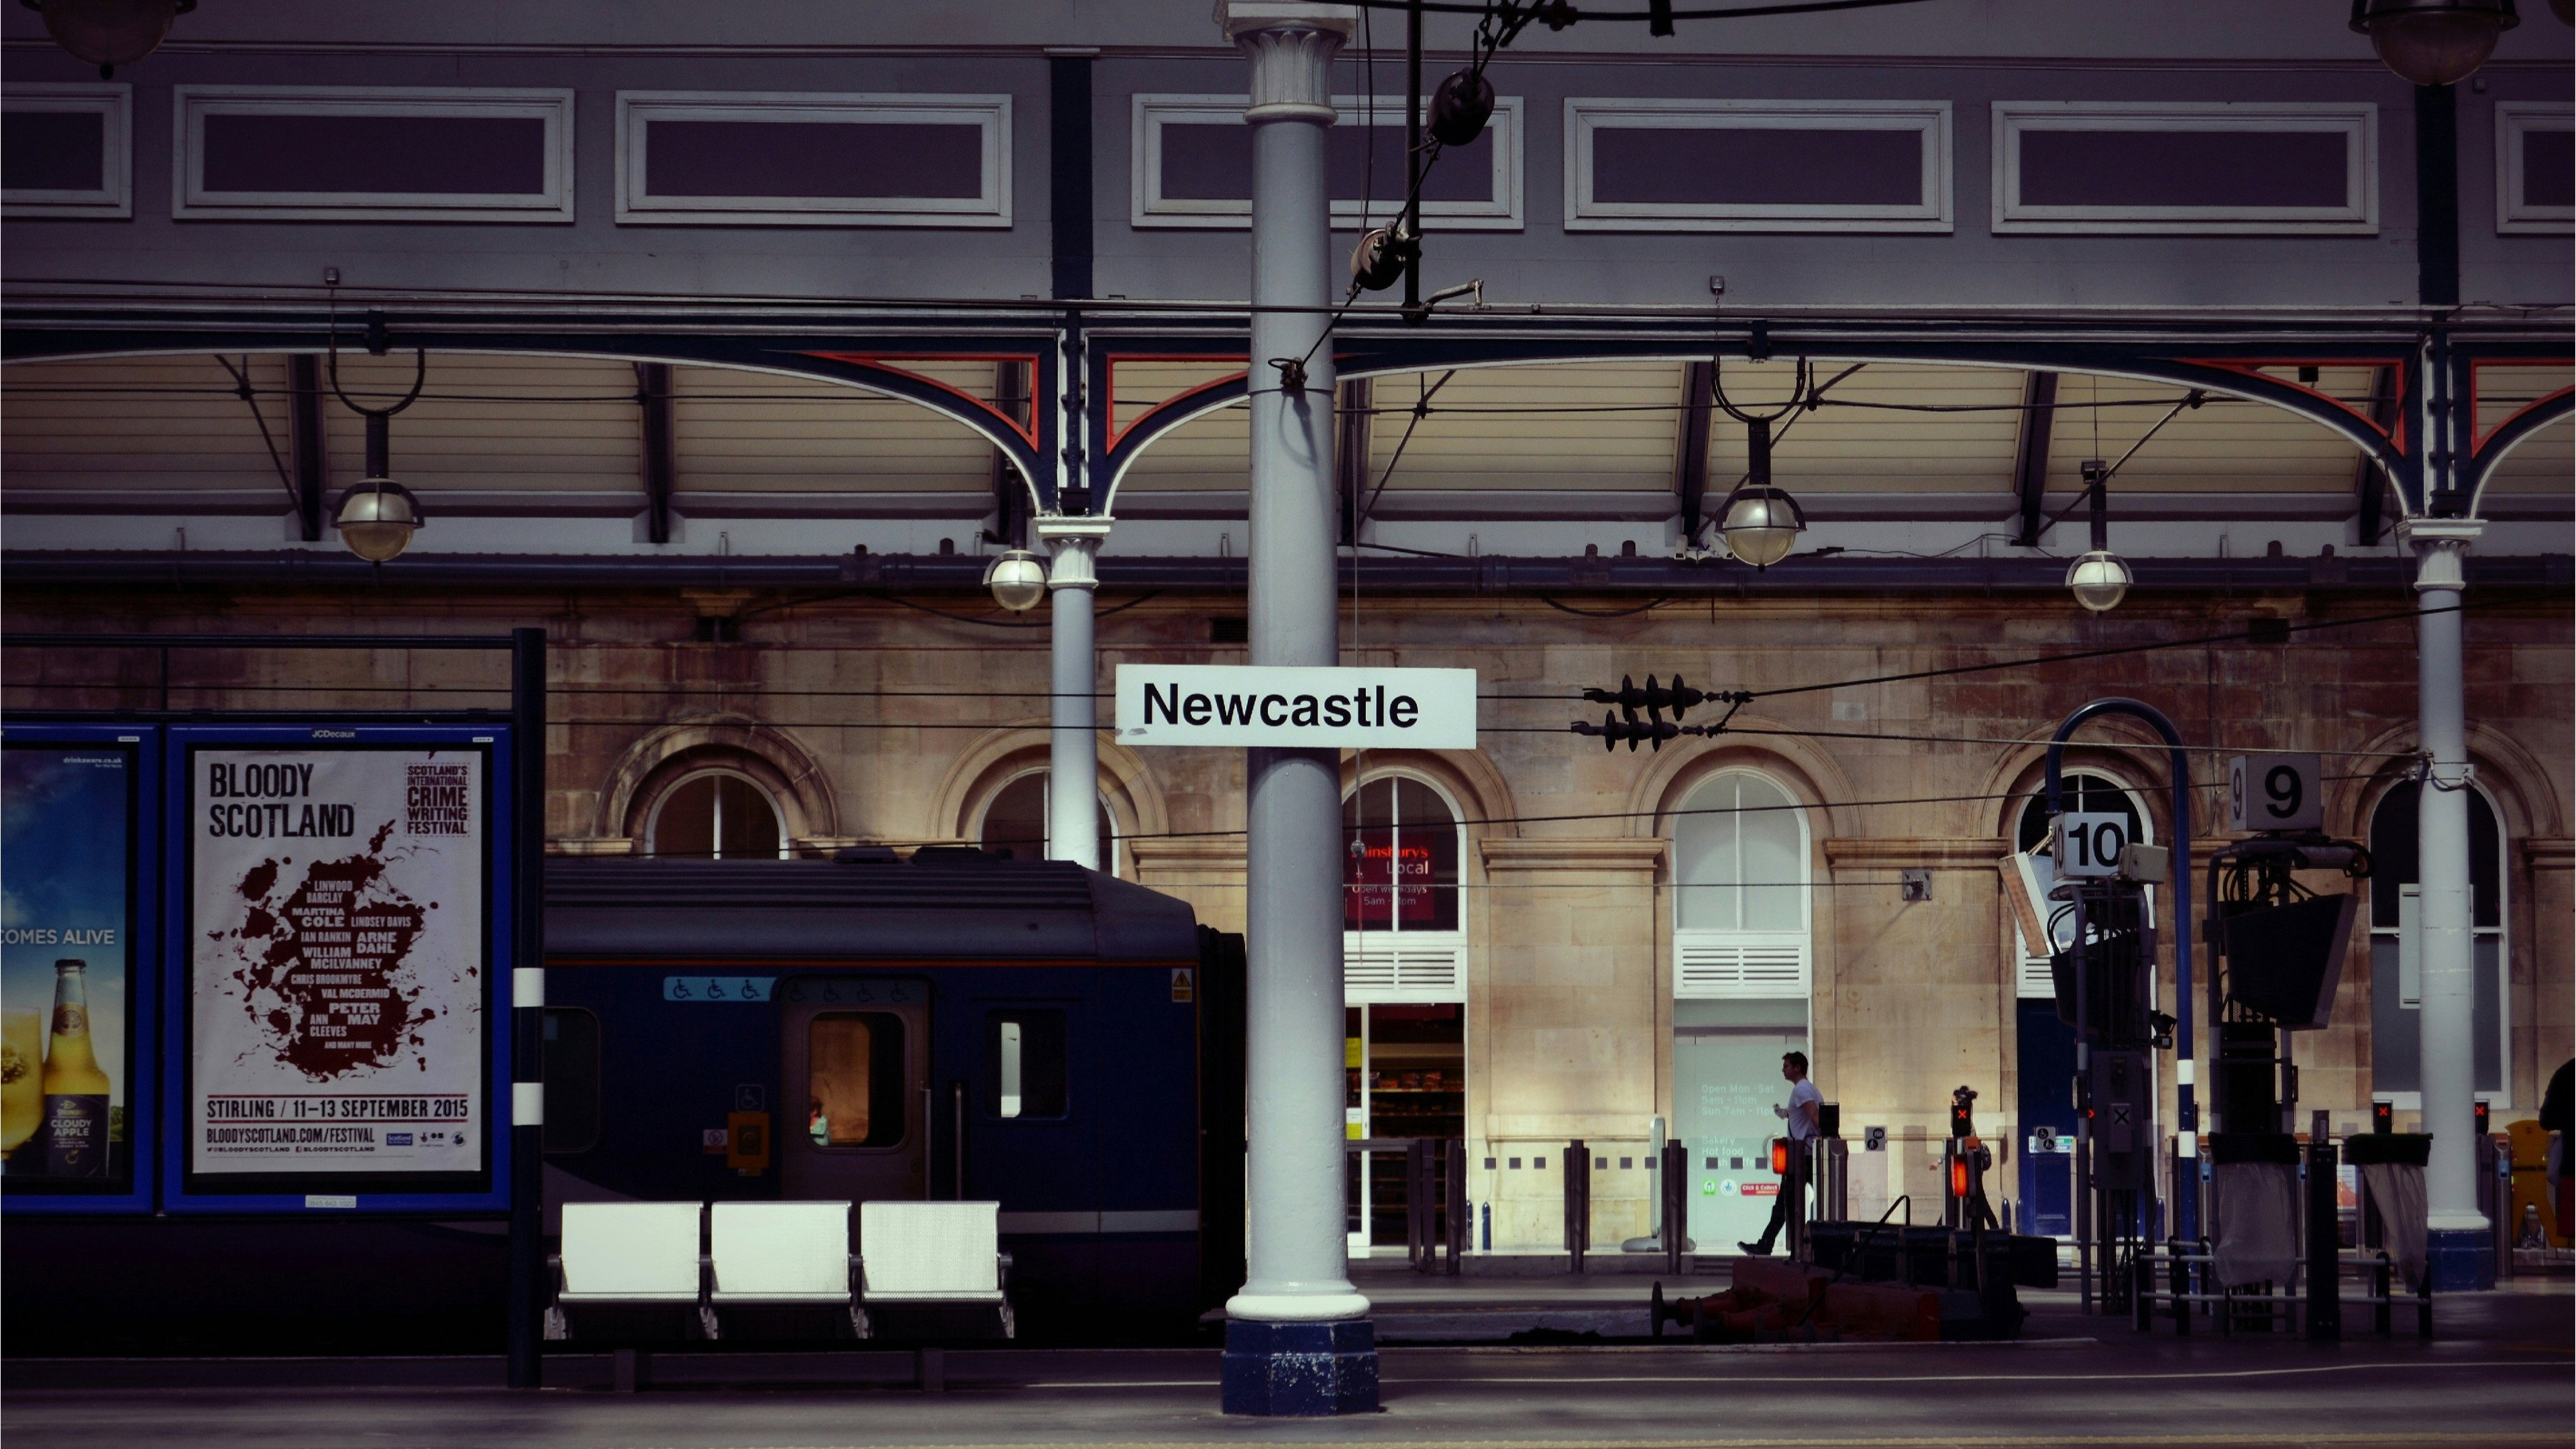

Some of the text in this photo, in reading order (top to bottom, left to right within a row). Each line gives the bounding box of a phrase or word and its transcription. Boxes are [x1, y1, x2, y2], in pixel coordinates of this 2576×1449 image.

[1144, 683, 1419, 728] Newcastle
[312, 730, 355, 738] JCDecaux
[407, 765, 468, 775] SCOTLAND'S
[210, 763, 314, 798] BLOODY
[407, 776, 468, 786] INTERNATIONAL
[407, 787, 468, 806] CRIME
[2264, 765, 2302, 818] 9
[407, 808, 468, 820] WRITING
[209, 804, 354, 838] SCOTLAND
[407, 821, 467, 835] FESTIVAL
[2068, 822, 2125, 867] 10
[1387, 861, 1428, 875] Local
[314, 880, 353, 892] LINWOOD
[306, 892, 343, 904] BARCLAY
[1364, 896, 1385, 906] 5am
[292, 908, 345, 916] MARTINA
[301, 916, 345, 928] COLE
[351, 916, 412, 928] LINDSEY DAVIS
[63, 929, 115, 945] ALIVE
[301, 931, 352, 943] IAN RANKIN
[356, 931, 397, 943] ARNE
[303, 947, 352, 958] WILLIAM
[356, 943, 396, 953] DAHL
[311, 959, 382, 969] MCILVANNEY
[291, 974, 362, 985] CHRIS BROOKMYRE
[321, 988, 390, 999] VAL MCDERMID
[329, 1002, 380, 1014] PETER
[310, 1014, 329, 1025] ANN
[347, 1014, 380, 1025] MAY
[310, 1026, 347, 1037] CLEEVES
[337, 1041, 354, 1049] MANY
[1701, 1084, 1726, 1094] Open
[1730, 1084, 1750, 1093] Mon
[1701, 1095, 1723, 1105] 5am
[1734, 1095, 1757, 1106] 11pm
[207, 1099, 275, 1118] STIRLING
[341, 1099, 428, 1118] SEPTEMBER
[434, 1099, 468, 1117] 2015
[1701, 1106, 1721, 1116] Sun
[1724, 1106, 1746, 1116] 7am
[51, 1119, 93, 1128] CLOUDY
[54, 1128, 90, 1137] APPLE
[207, 1128, 375, 1143] BLOODYSCOTLAND.COM/FESTIVAL
[1701, 1136, 1735, 1146] Bakery
[1702, 1147, 1743, 1156] Hot food
